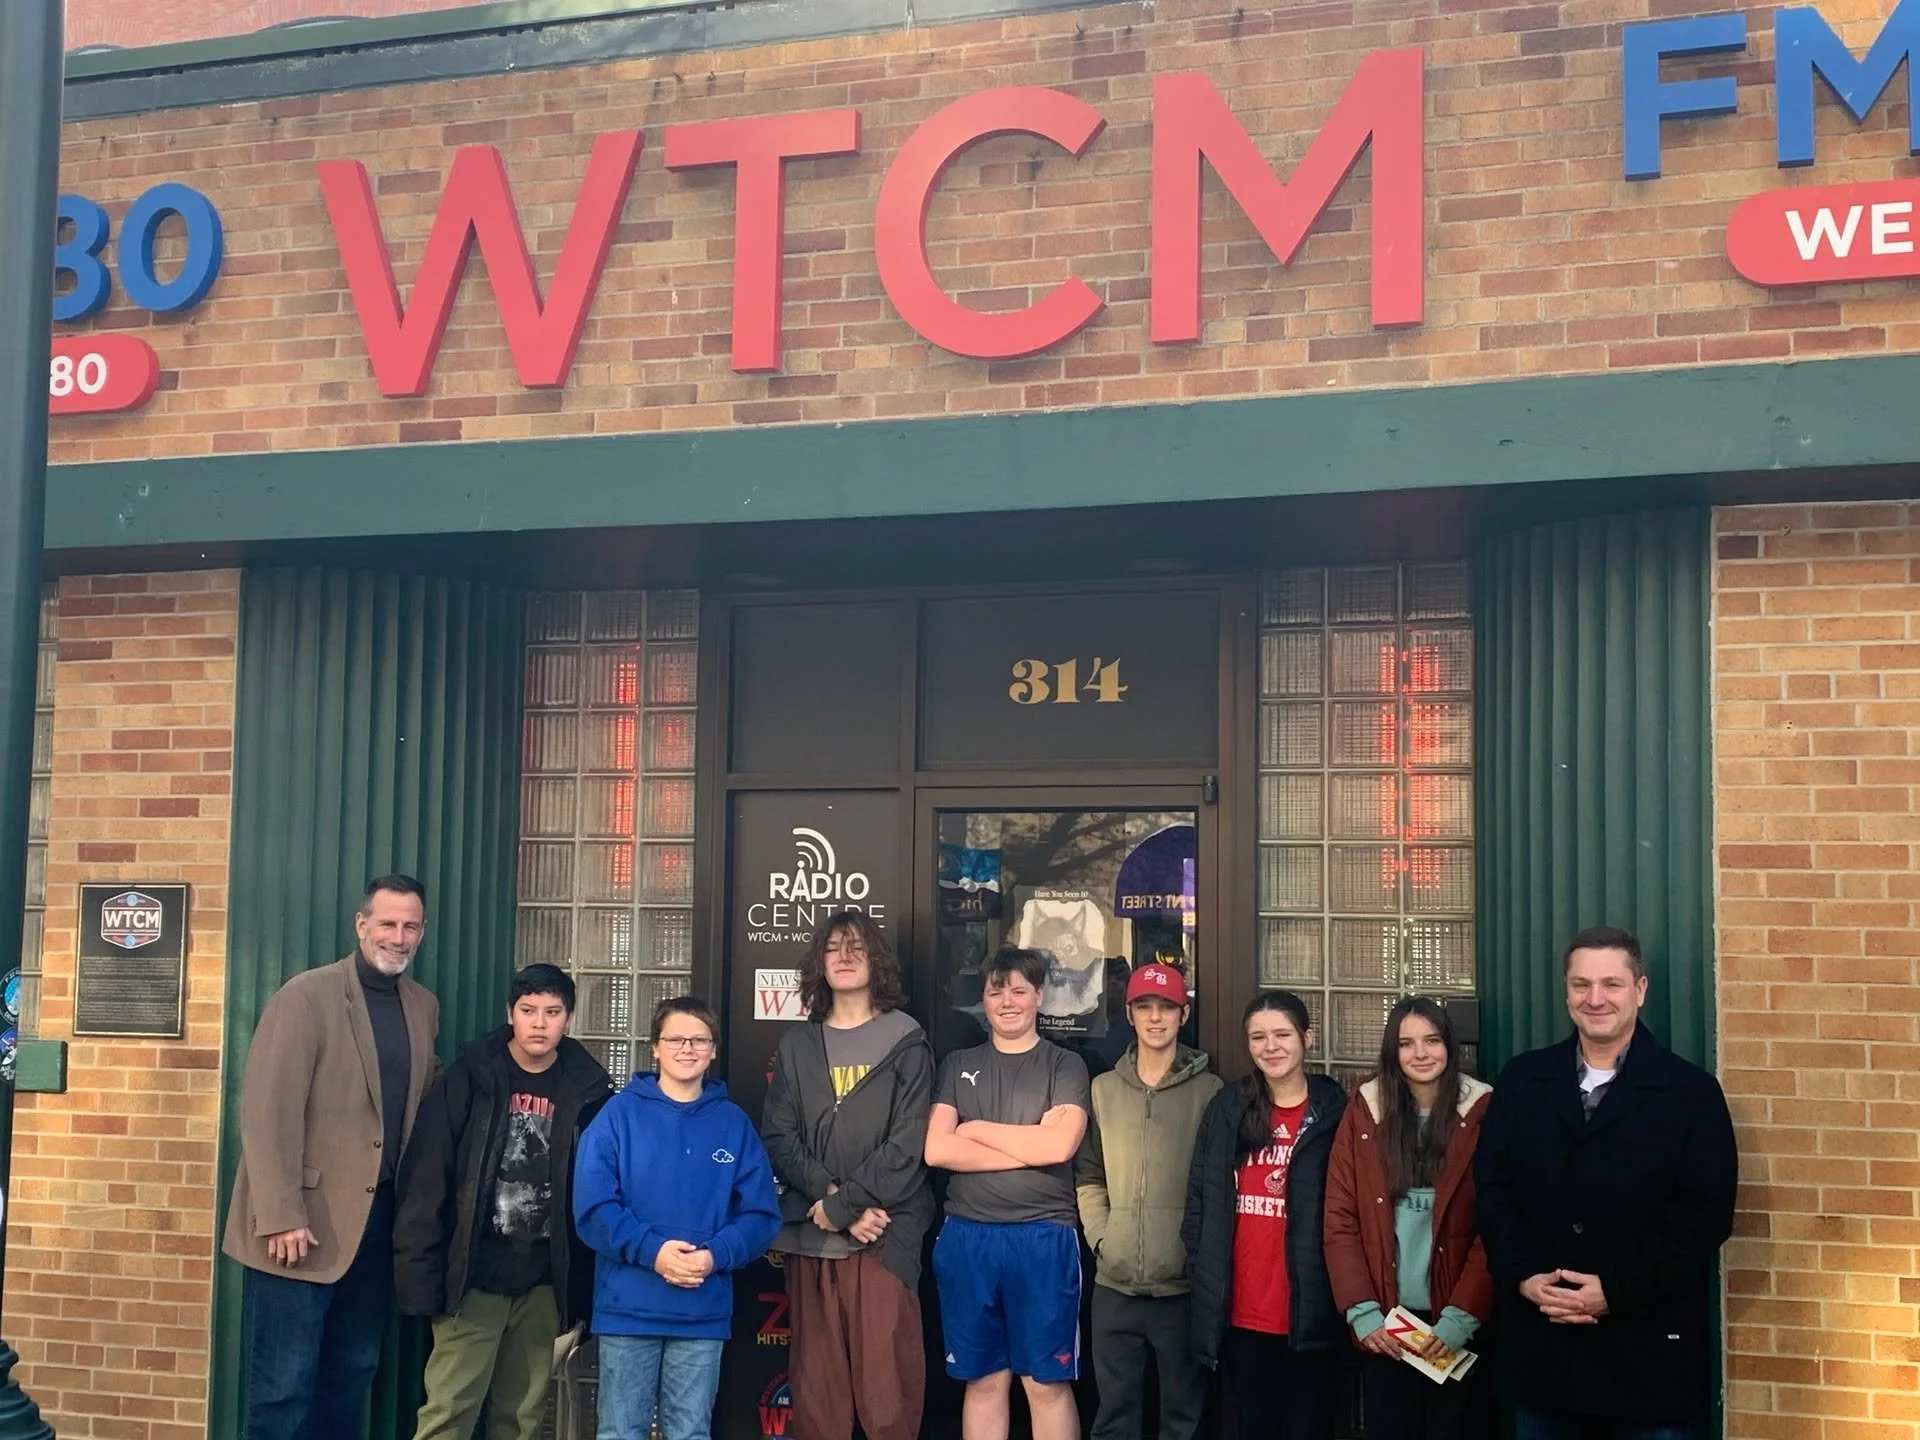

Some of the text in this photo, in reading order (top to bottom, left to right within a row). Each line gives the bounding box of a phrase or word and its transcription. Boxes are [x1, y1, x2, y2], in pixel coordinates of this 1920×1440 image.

[1621, 0, 1920, 182] FM
[317, 48, 1424, 397] WTCM
[1784, 201, 1914, 261] WE
[1008, 657, 1129, 705] 314
[769, 868, 870, 902] RADIO
[1051, 889, 1063, 898] You
[1064, 889, 1080, 898] Seen
[104, 910, 160, 928] WTCM
[747, 932, 815, 943] WTCM WC
[760, 973, 800, 987] NEWS
[1039, 1016, 1076, 1027] The Legend
[756, 1332, 788, 1346] HITS
